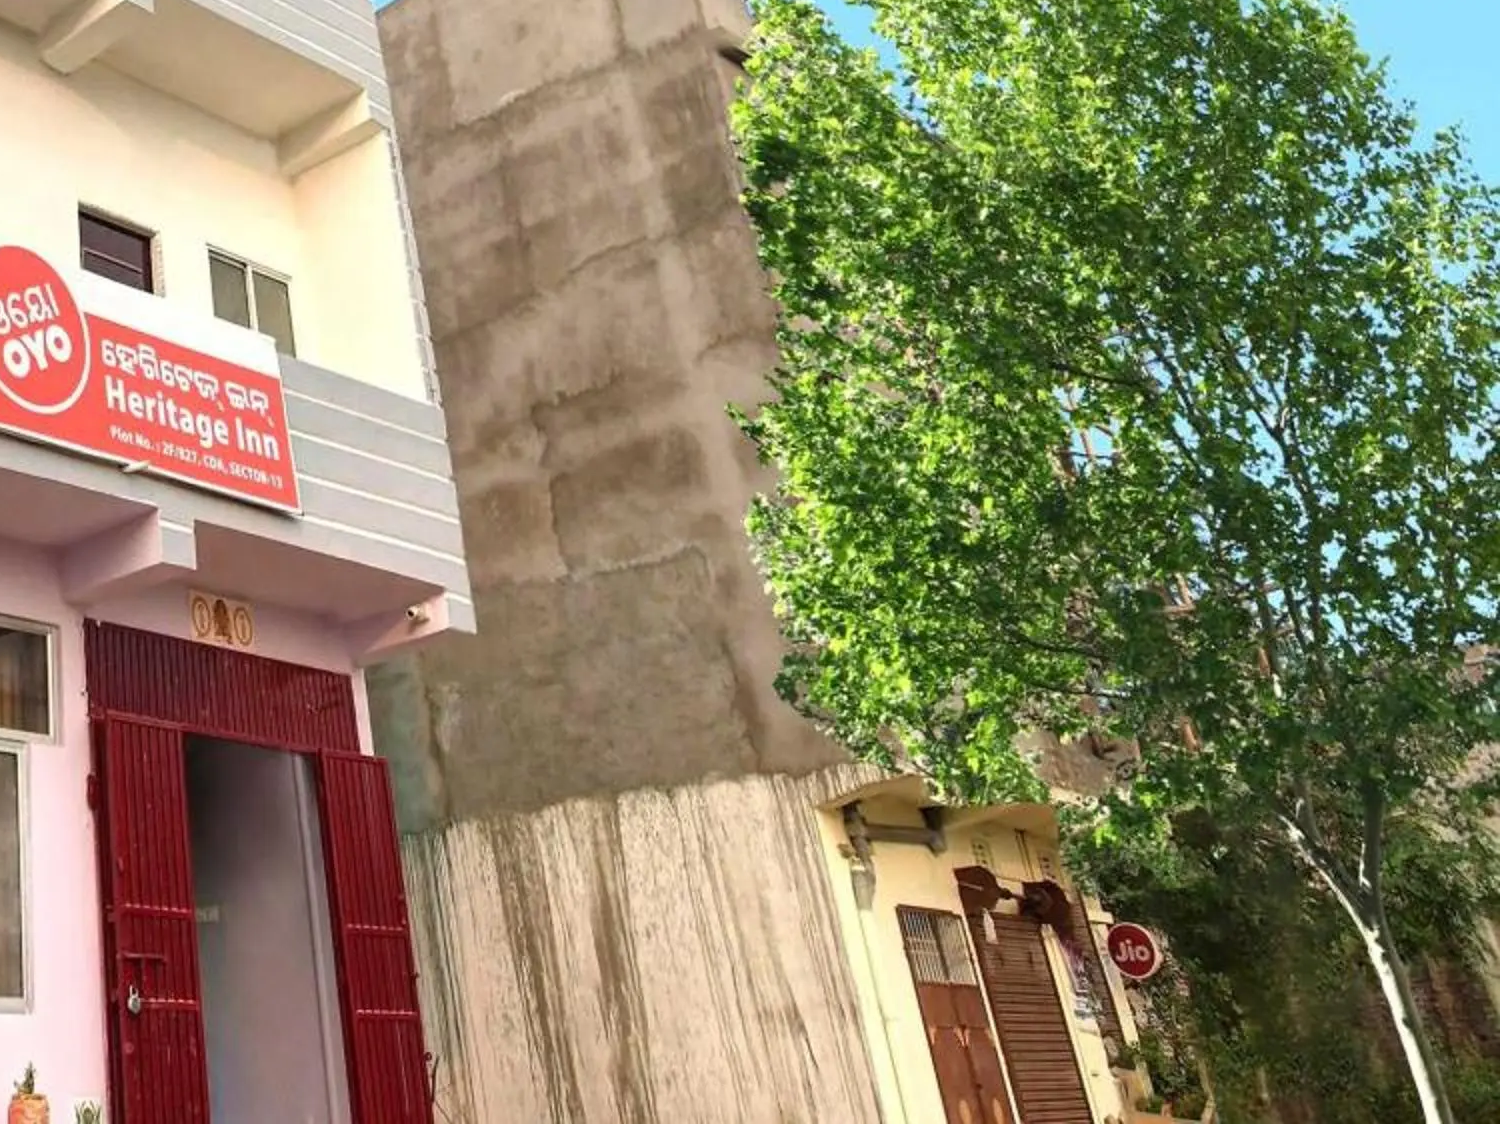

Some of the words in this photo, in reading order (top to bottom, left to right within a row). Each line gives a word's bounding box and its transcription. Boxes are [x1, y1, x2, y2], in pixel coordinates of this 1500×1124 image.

[3, 324, 72, 378] OYO
[104, 375, 229, 449] Heritage
[235, 417, 280, 461] Inn
[110, 424, 134, 445] Plot
[1115, 938, 1151, 963] Jio
